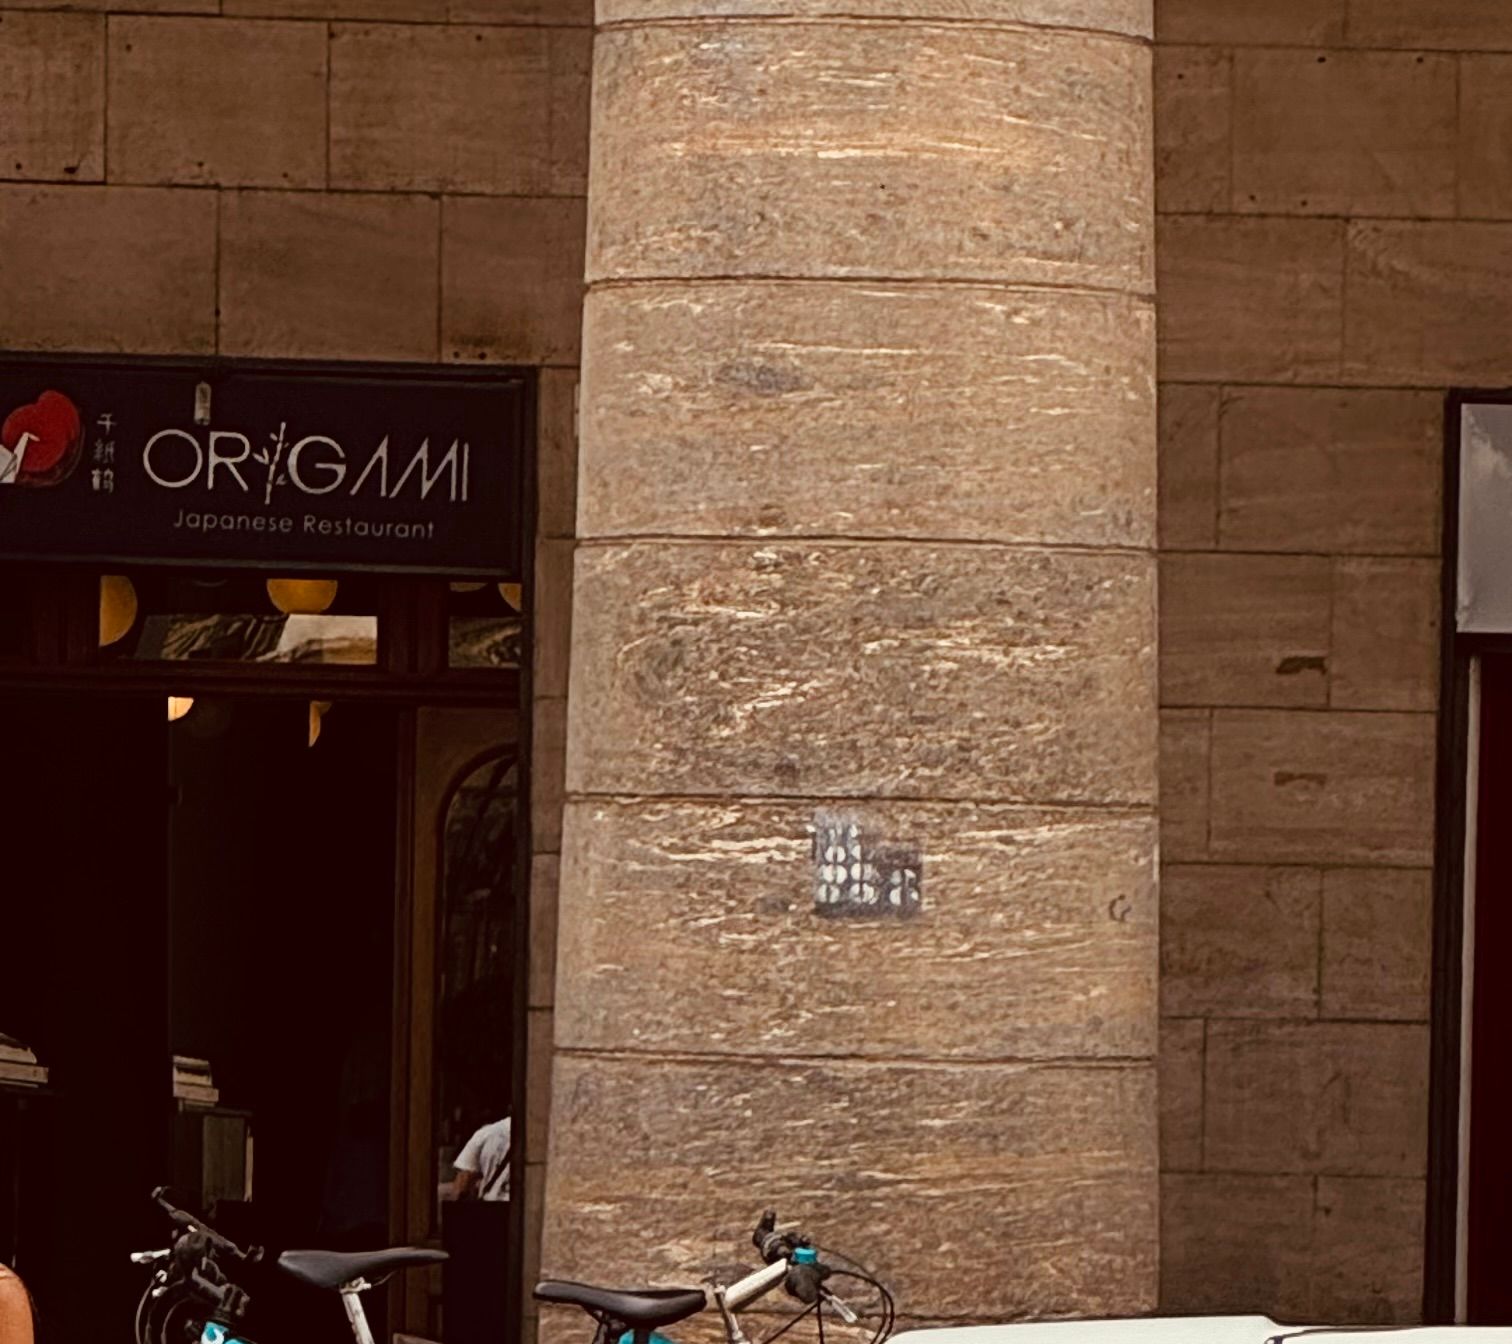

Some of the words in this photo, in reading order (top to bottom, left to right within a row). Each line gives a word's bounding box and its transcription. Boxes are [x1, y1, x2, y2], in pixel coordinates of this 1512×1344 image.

[143, 422, 470, 504] ORIGAMI
[174, 508, 293, 533] Japanese
[303, 514, 435, 540] Restaurant
